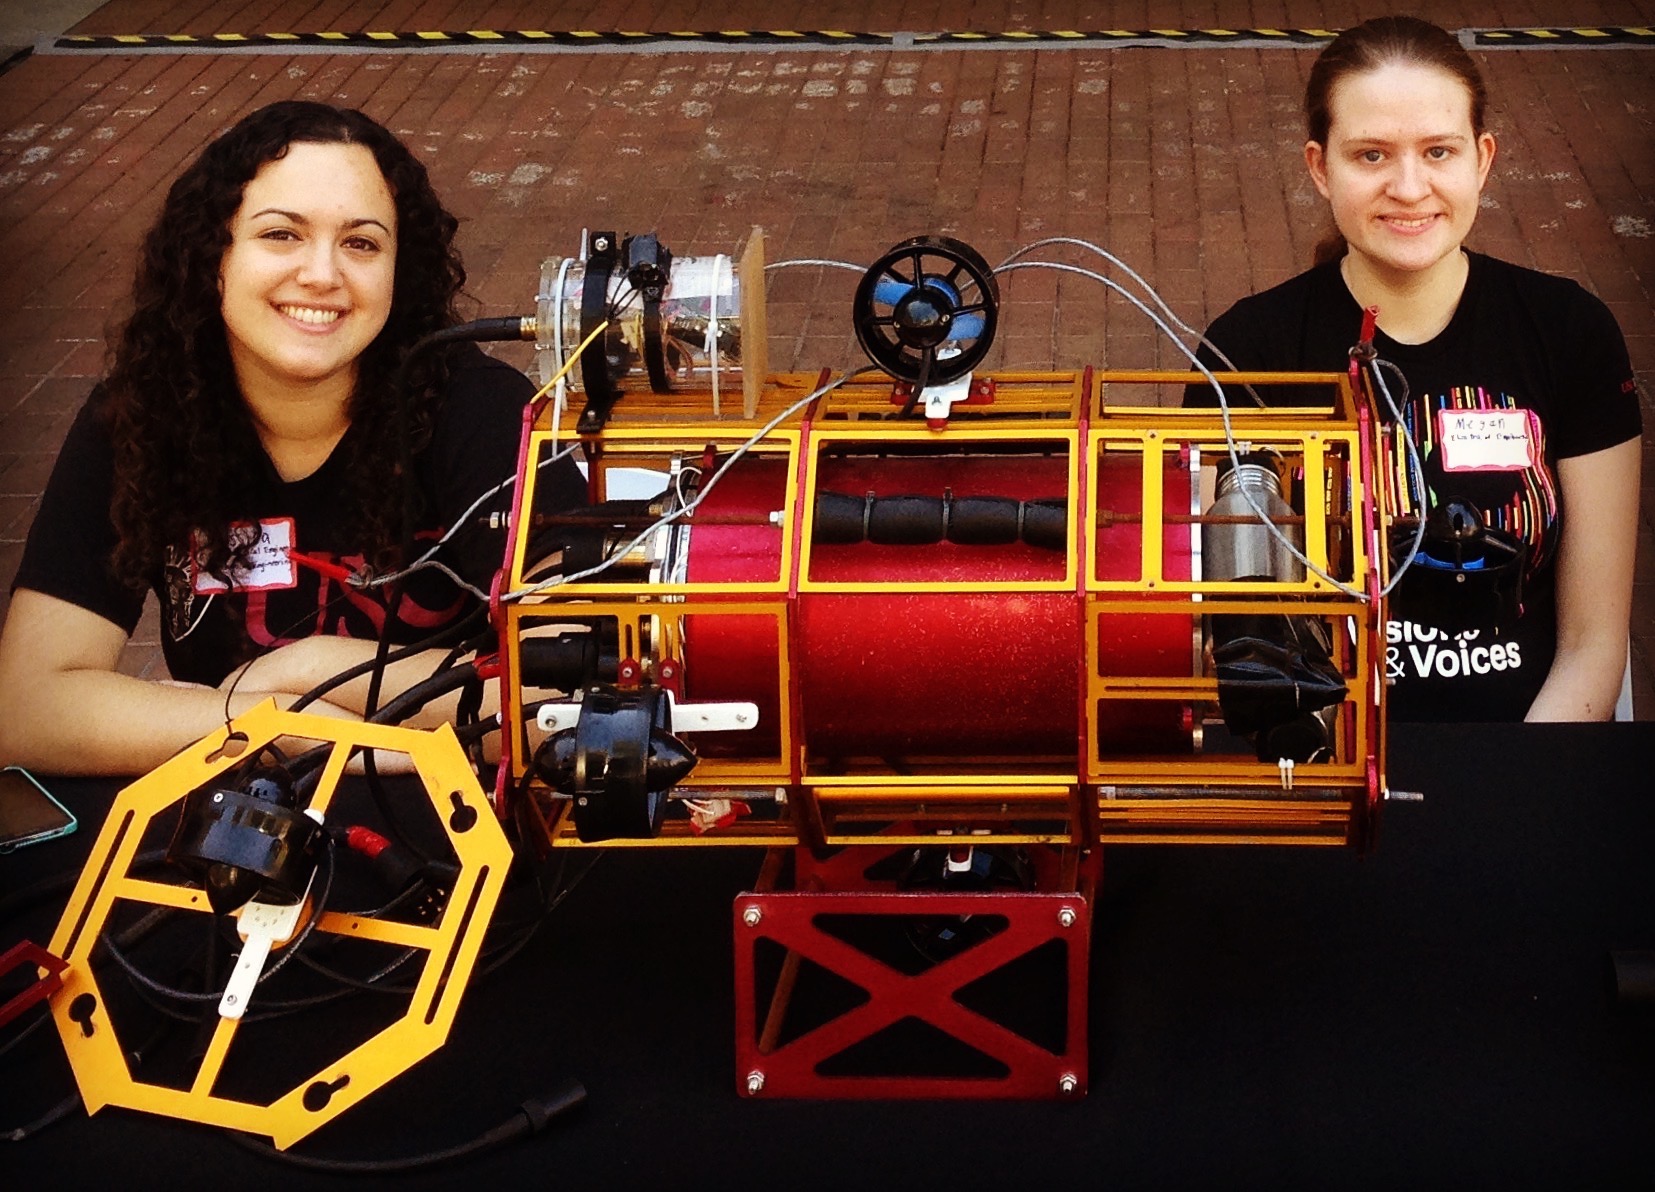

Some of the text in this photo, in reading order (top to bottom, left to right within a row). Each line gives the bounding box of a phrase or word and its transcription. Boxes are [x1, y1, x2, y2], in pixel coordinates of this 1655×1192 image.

[1455, 417, 1506, 431] Megan
[1385, 639, 1522, 679] & Voices
